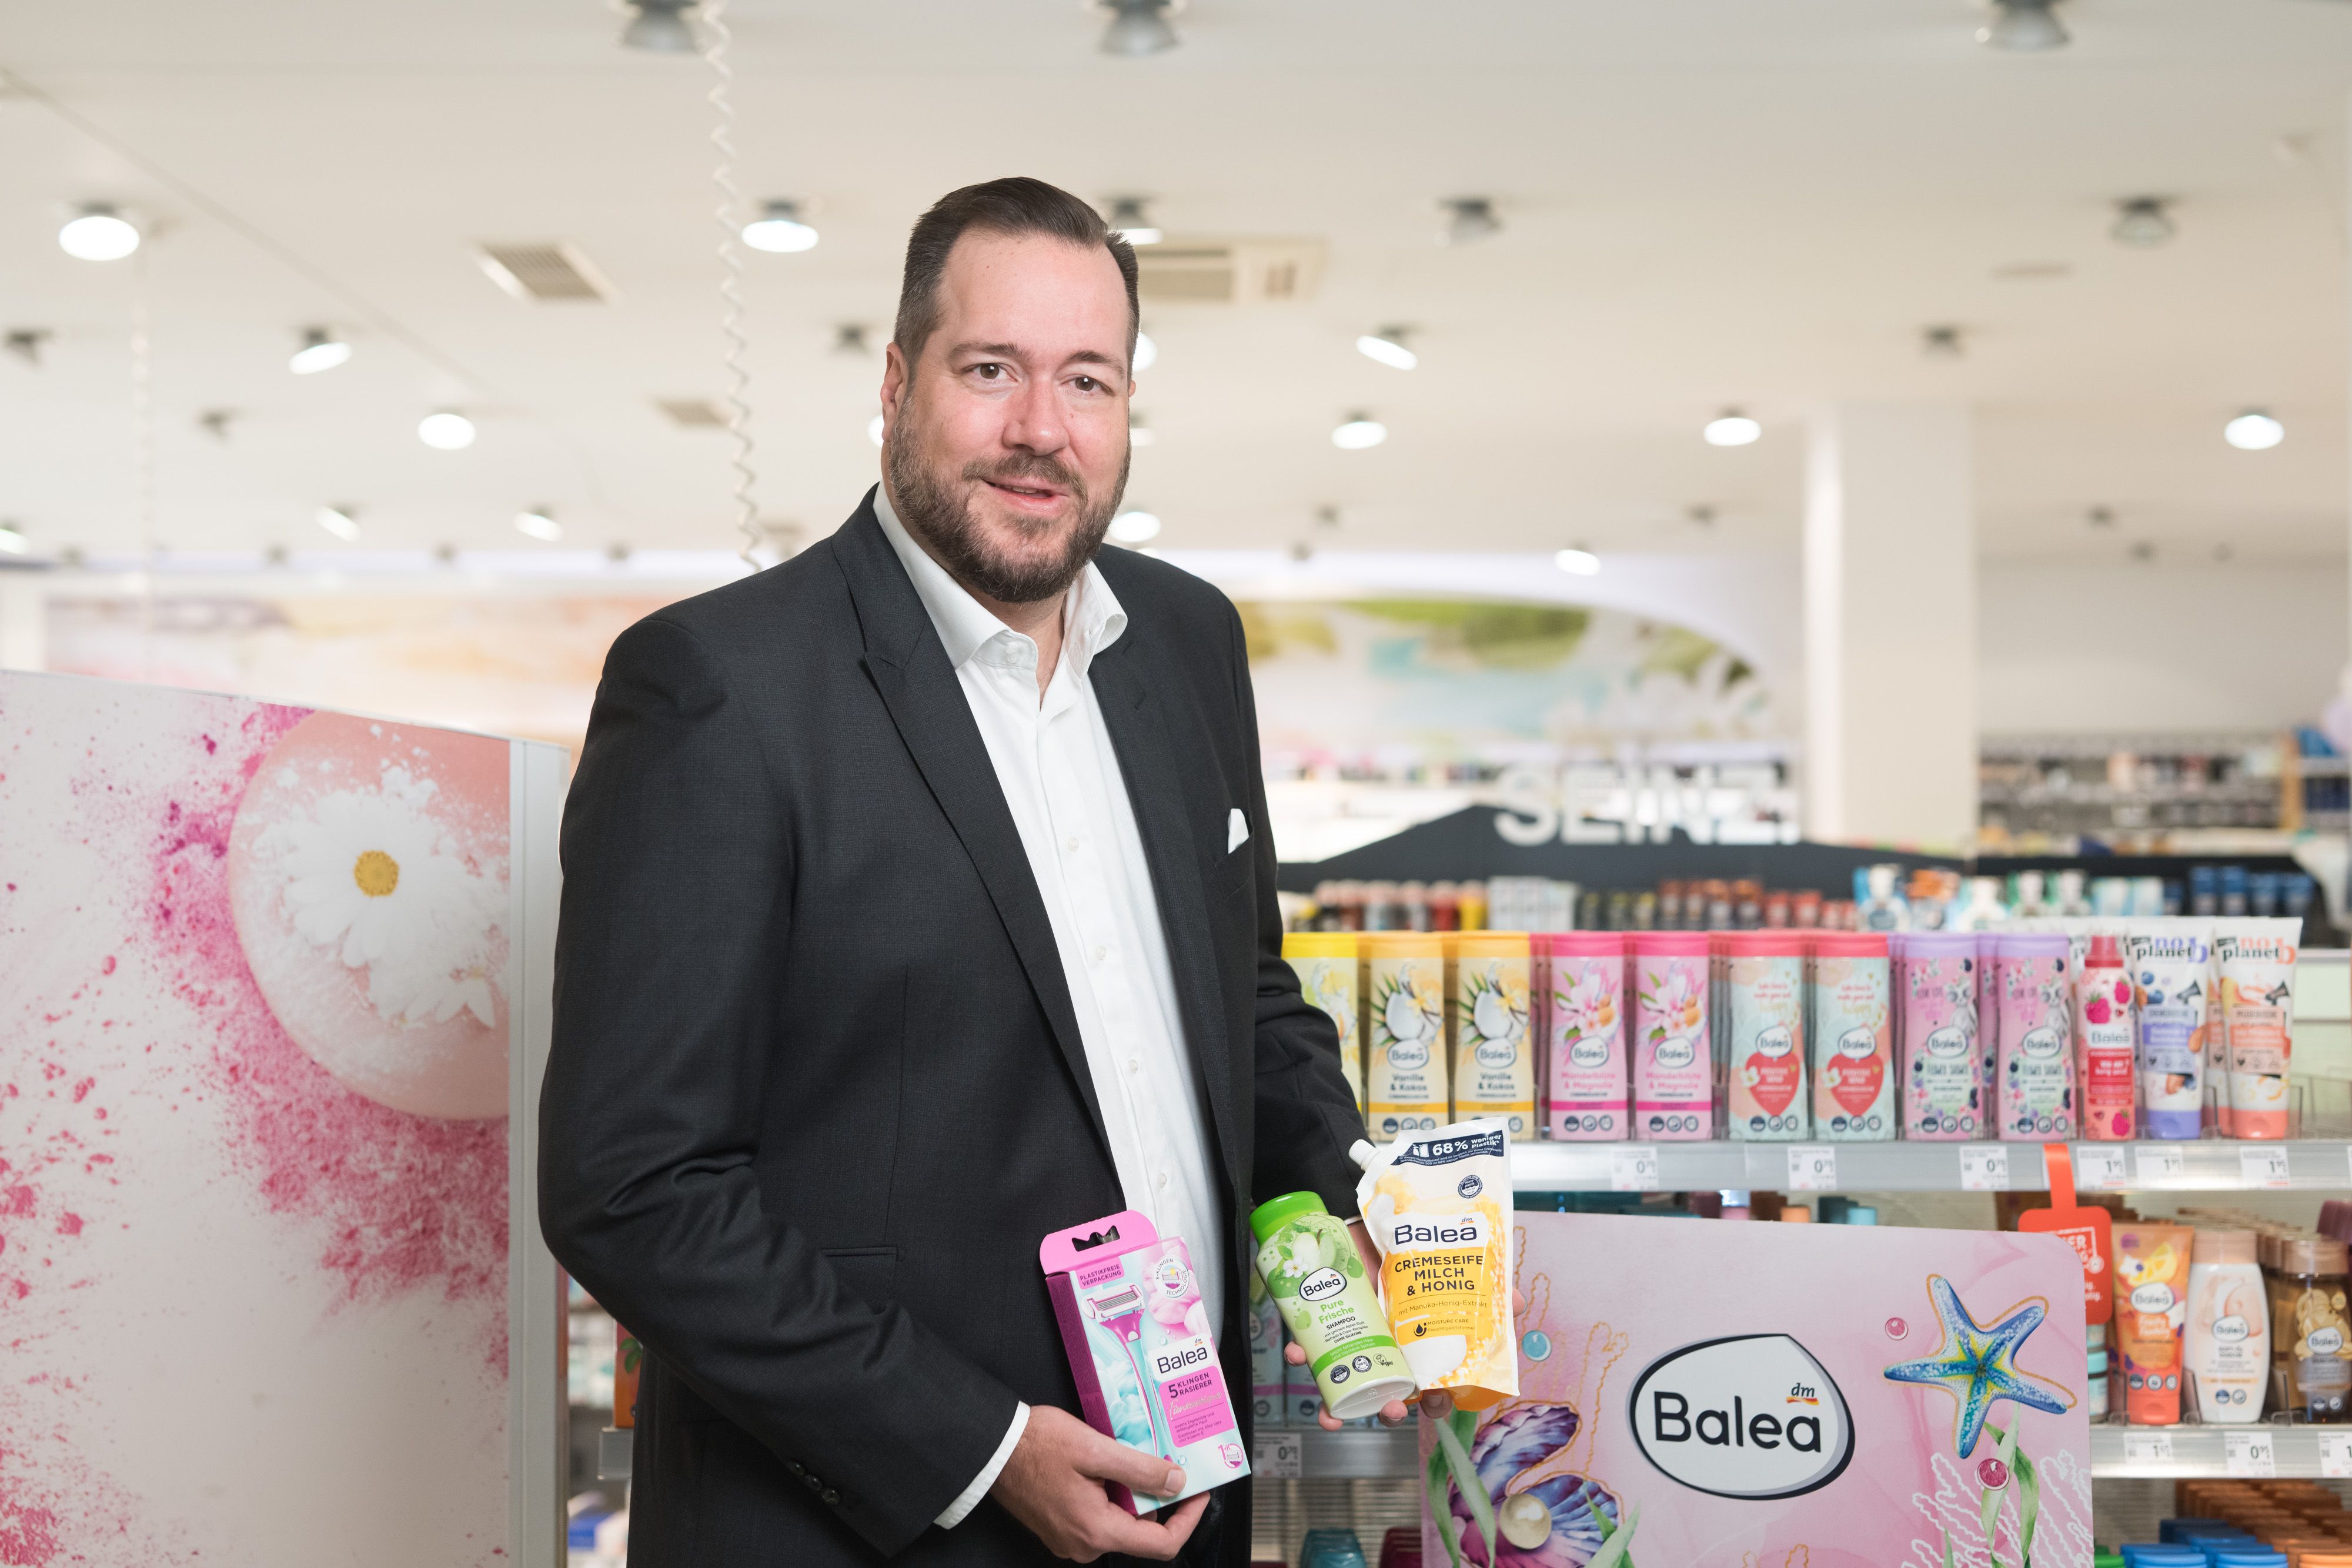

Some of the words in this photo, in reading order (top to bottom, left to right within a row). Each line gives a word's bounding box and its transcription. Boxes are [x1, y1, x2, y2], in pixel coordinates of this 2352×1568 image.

[2136, 944, 2192, 959] planet
[2223, 945, 2280, 961] planet
[1399, 1083, 1427, 1091] Kokos
[1487, 1082, 1515, 1090] Kokos
[1432, 1140, 1469, 1156] 68%
[1394, 1224, 1477, 1245] Balea
[1155, 1258, 1174, 1280] 5-KLINGEN
[1395, 1255, 1485, 1273] CREMESEIFE
[1080, 1264, 1120, 1281] PLASTIKFREIE
[1082, 1270, 1121, 1286] VERPACKUNG
[1414, 1268, 1464, 1281] MILCH
[1166, 1269, 1187, 1296] TECHNOLOGIE
[1303, 1278, 1341, 1296] Balea
[1407, 1285, 1416, 1296] &
[1421, 1280, 1475, 1292] HONIG
[1319, 1300, 1344, 1312] Pure
[1318, 1307, 1355, 1324] Frische
[1326, 1316, 1356, 1330] SHAMPOO
[1325, 1334, 1339, 1343] Refresh
[1342, 1325, 1368, 1335] Care-Komplex
[1332, 1326, 1345, 1335] grünem
[1157, 1347, 1208, 1374] Balea
[1168, 1383, 1178, 1398] 5
[1177, 1372, 1210, 1388] KLINGEN
[1179, 1379, 1212, 1396] RASIERER
[1790, 1382, 1815, 1397] dm
[1187, 1415, 1207, 1425] Ergebnisse
[1653, 1391, 1822, 1453] Balea
